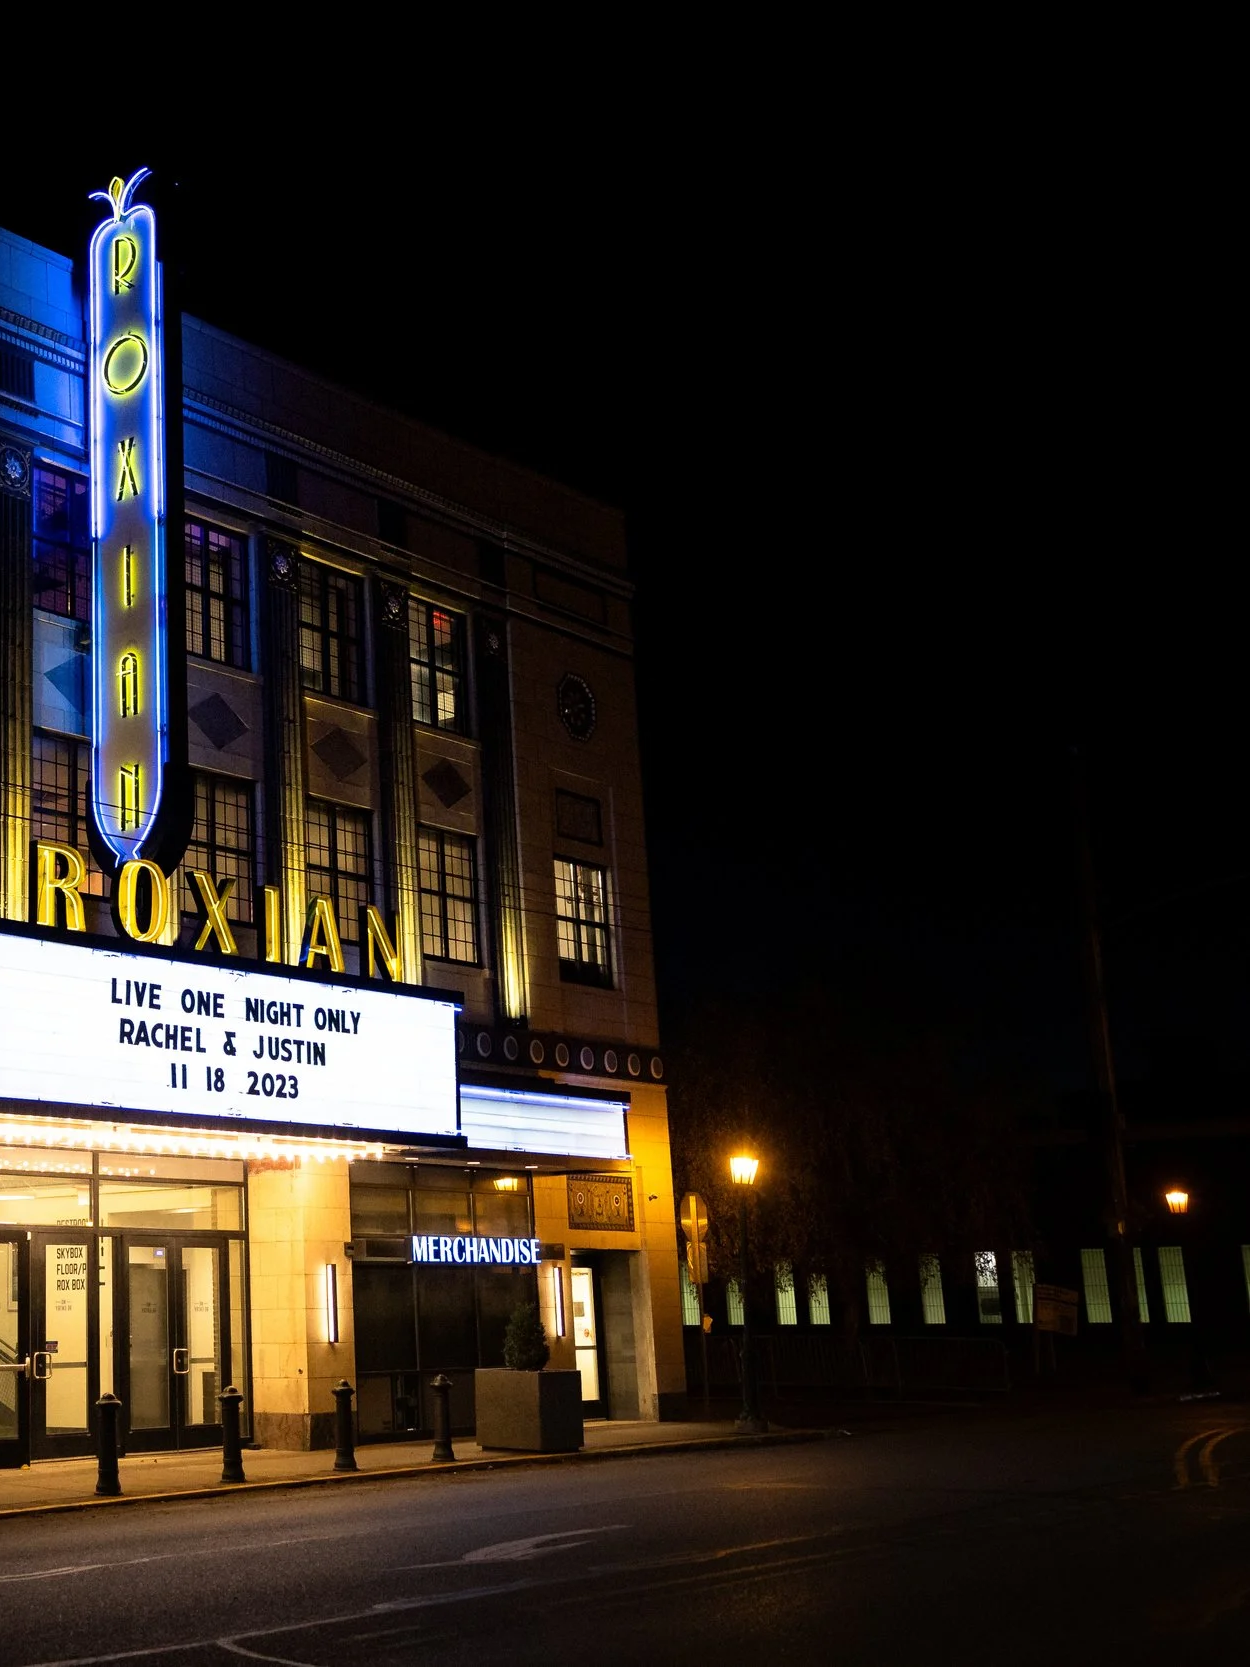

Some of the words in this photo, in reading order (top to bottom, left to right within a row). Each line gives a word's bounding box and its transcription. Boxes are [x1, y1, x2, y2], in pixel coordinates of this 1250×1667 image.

[103, 235, 149, 833] ROXIAN
[34, 839, 403, 983] ROXIAN
[111, 977, 162, 1010] LIVE
[180, 988, 225, 1019] ONE
[245, 997, 304, 1028] NIGHT
[314, 1007, 361, 1035] ONLY
[119, 1017, 207, 1053] RACHEL
[222, 1030, 236, 1057] &
[253, 1035, 326, 1067] JUSTIN
[170, 1062, 188, 1090] 11
[206, 1066, 225, 1092] 18
[246, 1071, 299, 1099] 2023
[56, 1247, 83, 1259] SKYBOX
[412, 1235, 542, 1264] MERCHANDISE
[56, 1279, 70, 1291] ROX
[71, 1279, 85, 1291] BOX
